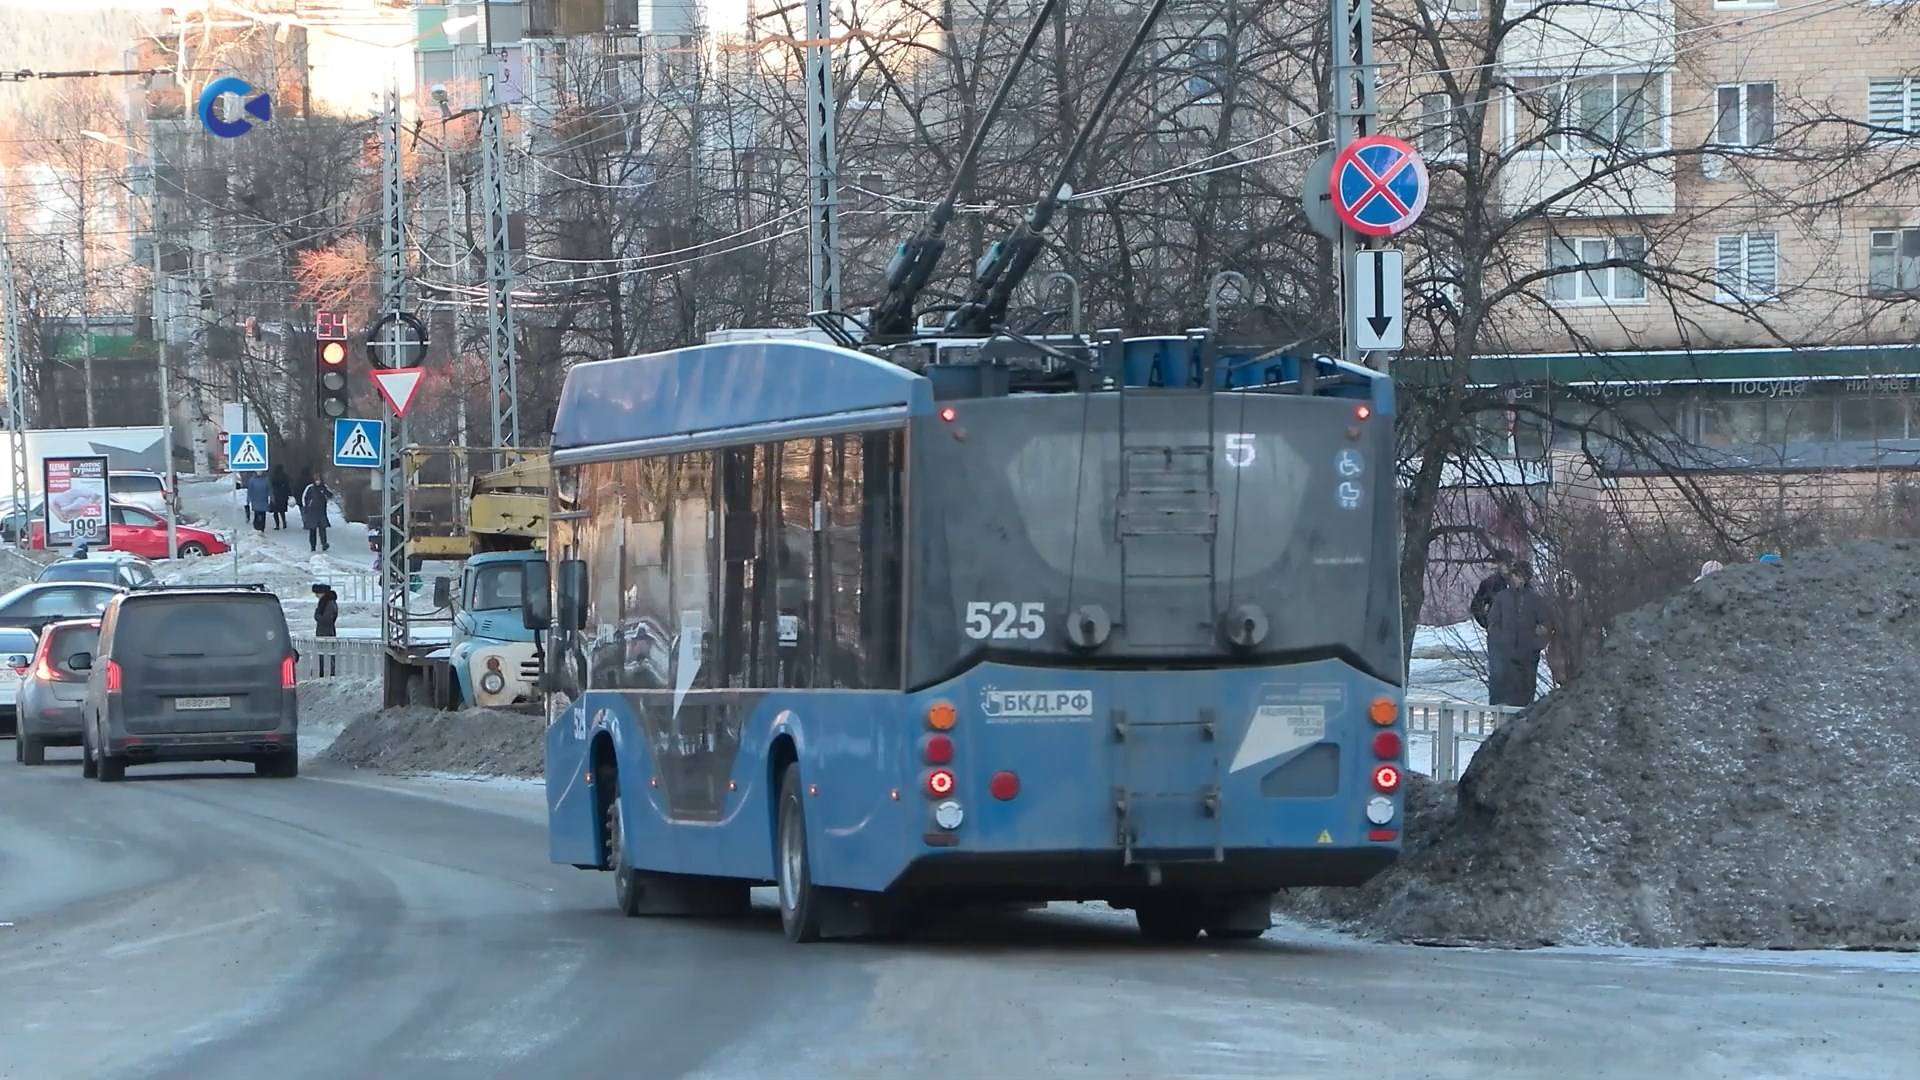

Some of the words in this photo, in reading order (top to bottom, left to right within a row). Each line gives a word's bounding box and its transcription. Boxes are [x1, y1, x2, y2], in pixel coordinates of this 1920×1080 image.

[1730, 380, 1806, 397] посуда
[1226, 433, 1256, 467] 5
[68, 518, 97, 538] 199
[965, 601, 1045, 640] 525
[1004, 694, 1089, 714] БКД.РФ
